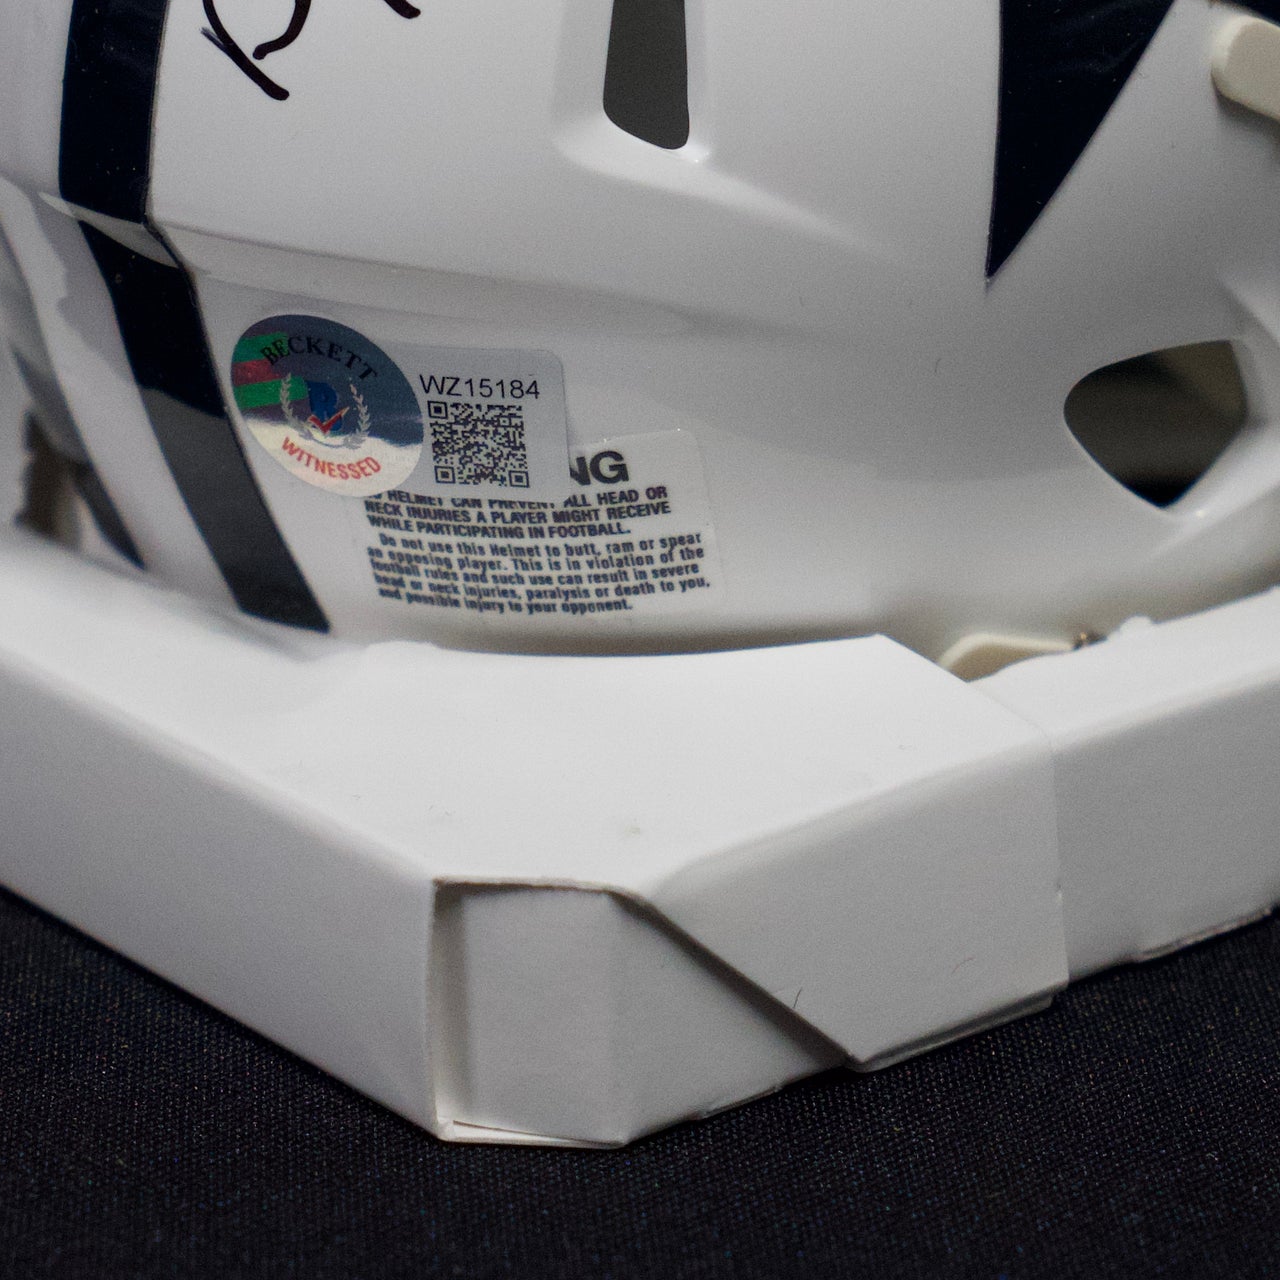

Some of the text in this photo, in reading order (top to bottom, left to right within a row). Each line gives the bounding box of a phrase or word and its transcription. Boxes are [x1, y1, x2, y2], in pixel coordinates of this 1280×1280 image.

[260, 335, 378, 381] BECKETT
[419, 374, 541, 400] WZ15184
[281, 436, 382, 481] WITNESSED
[597, 490, 639, 505] HEAD
[646, 486, 668, 500] OR
[364, 500, 671, 524] NECK INJURIES A PLAYER MIGHT RECEIVE
[366, 514, 632, 539] WHILE PARTICIPATING IN FOOTBALL.
[456, 542, 486, 556] this
[489, 543, 542, 558] Helmet
[544, 544, 561, 557] to
[606, 541, 635, 554] ram
[640, 540, 654, 550] or
[659, 533, 702, 552] spear
[511, 558, 543, 571] This
[549, 558, 561, 570] is
[566, 558, 580, 570] in
[586, 555, 654, 569] violation
[660, 550, 674, 563] of
[680, 548, 704, 561] the
[491, 572, 526, 586] such
[528, 575, 554, 586] use
[557, 574, 584, 586] can
[587, 569, 630, 585] result
[634, 568, 647, 580] in
[652, 564, 699, 578] severe
[525, 586, 591, 602] paralysis
[595, 588, 609, 597] or
[614, 582, 655, 596] death
[660, 580, 674, 591] to
